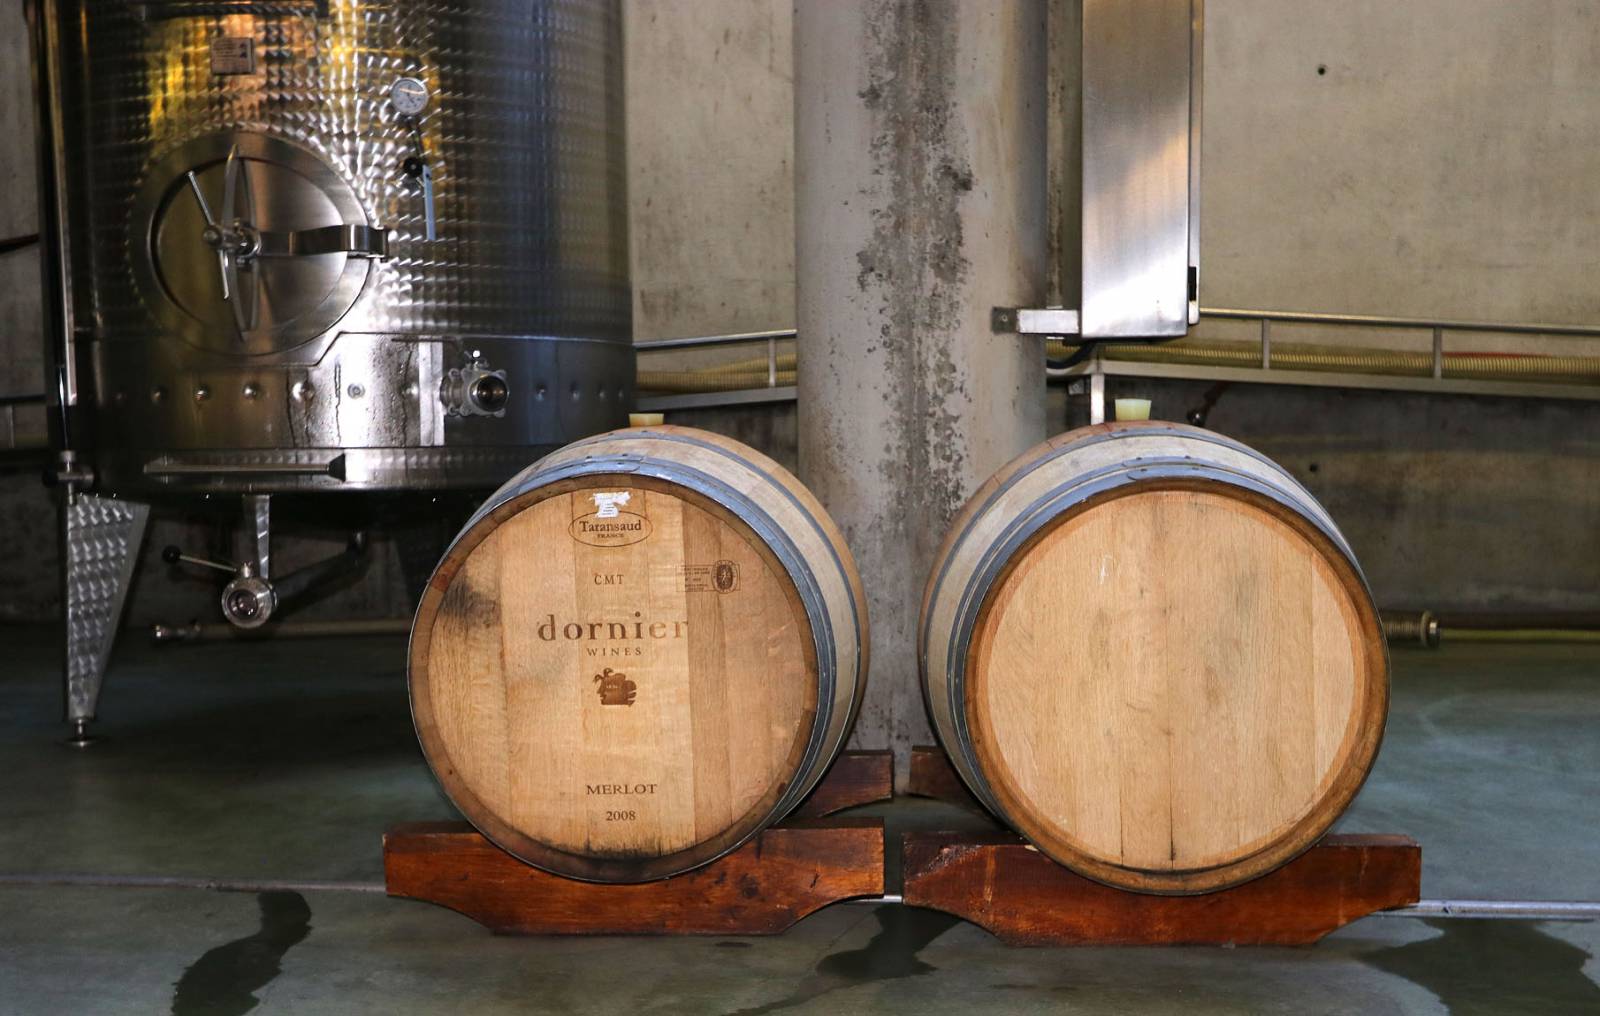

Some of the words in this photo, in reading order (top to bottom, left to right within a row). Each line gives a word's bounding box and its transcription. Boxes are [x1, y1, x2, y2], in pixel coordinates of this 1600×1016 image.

[579, 519, 642, 533] Taransaud
[594, 574, 625, 585] CMT
[538, 611, 689, 642] dornier
[587, 647, 642, 656] WINES
[587, 784, 657, 795] MERLOT
[606, 810, 636, 821] 2008
